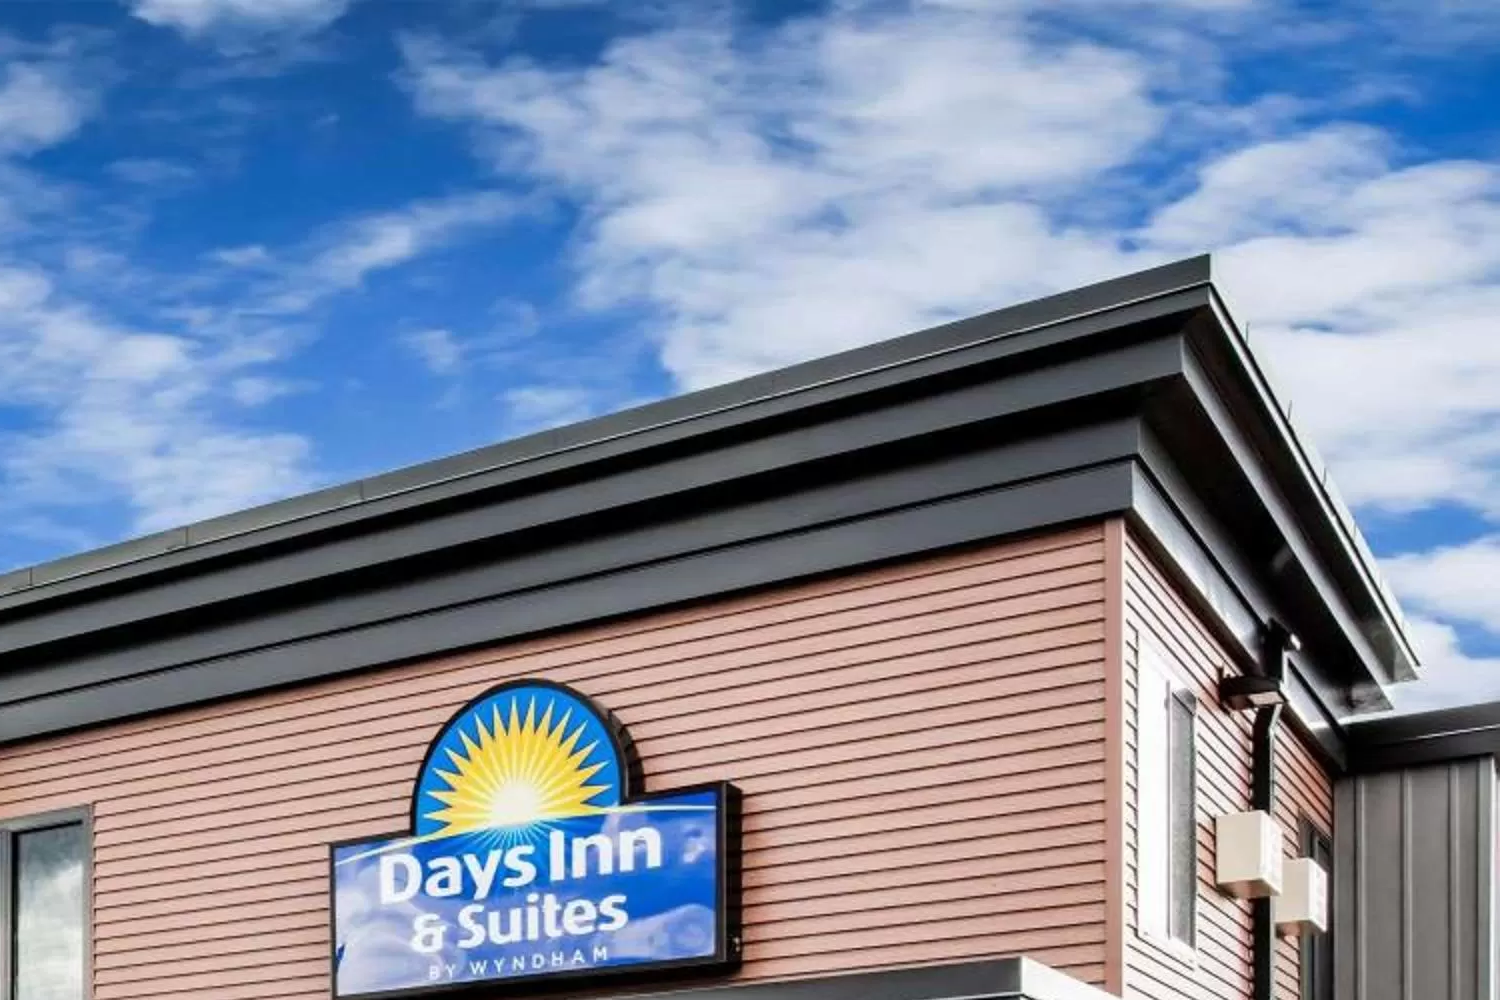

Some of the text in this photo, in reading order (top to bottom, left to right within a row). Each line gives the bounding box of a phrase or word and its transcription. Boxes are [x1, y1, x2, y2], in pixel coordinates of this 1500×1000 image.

[379, 826, 661, 905] Days Inn
[411, 892, 629, 953] & Suites
[428, 946, 608, 980] BY WYNDHAM
